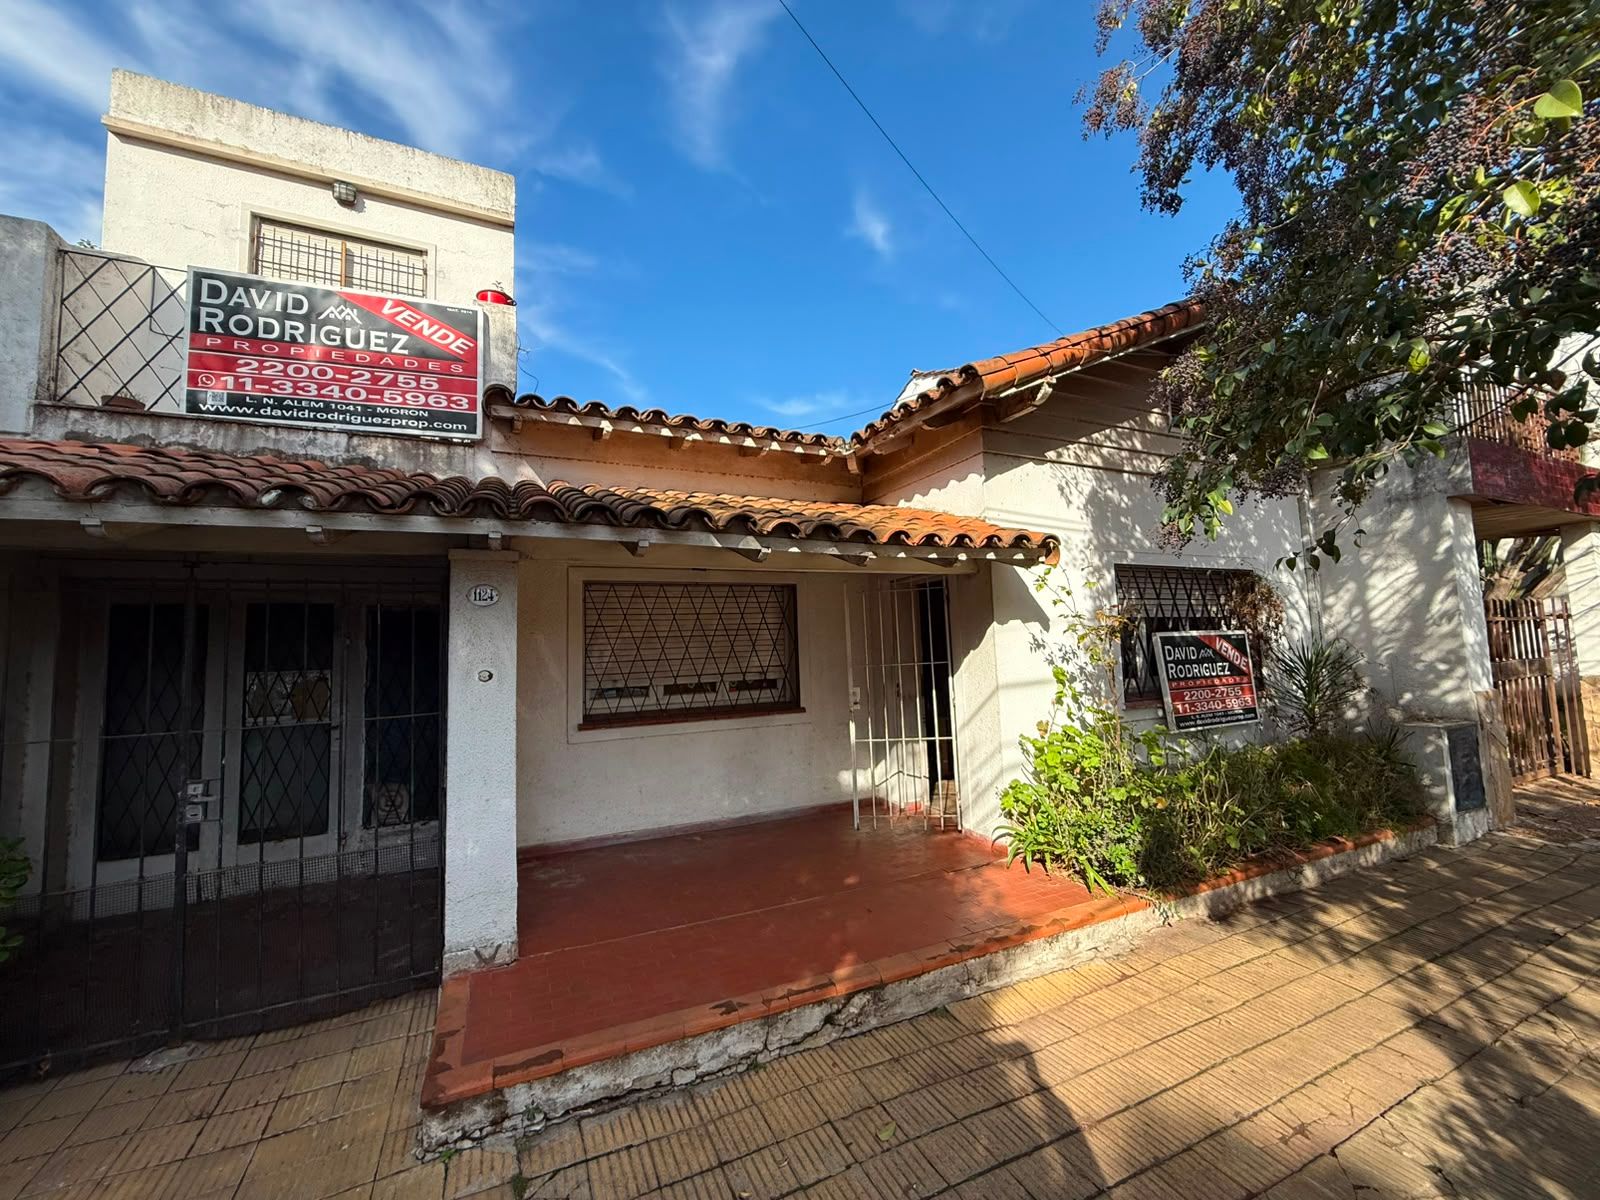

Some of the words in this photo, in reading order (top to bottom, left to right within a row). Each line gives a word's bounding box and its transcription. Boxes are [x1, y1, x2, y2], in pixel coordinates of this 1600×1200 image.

[199, 277, 309, 315] DAVID
[198, 306, 410, 355] RODRIGUEZ
[381, 299, 475, 355] VENDE
[206, 337, 464, 373] PROPIEDADES
[235, 359, 440, 391] 2200-2755
[220, 375, 470, 410] 11-3340-5963
[198, 403, 468, 431] www.davidrodriguezprop.com
[282, 399, 324, 409] ALEM
[329, 403, 362, 413] 1041
[375, 407, 429, 417] MORON
[474, 588, 494, 601] 1124
[1164, 645, 1197, 661] DAVID
[1214, 636, 1248, 671] VENDE
[1167, 662, 1231, 679] RODRIGUEZ
[1176, 697, 1252, 714] 11-3340-5963
[1183, 687, 1242, 701] 2200-2755
